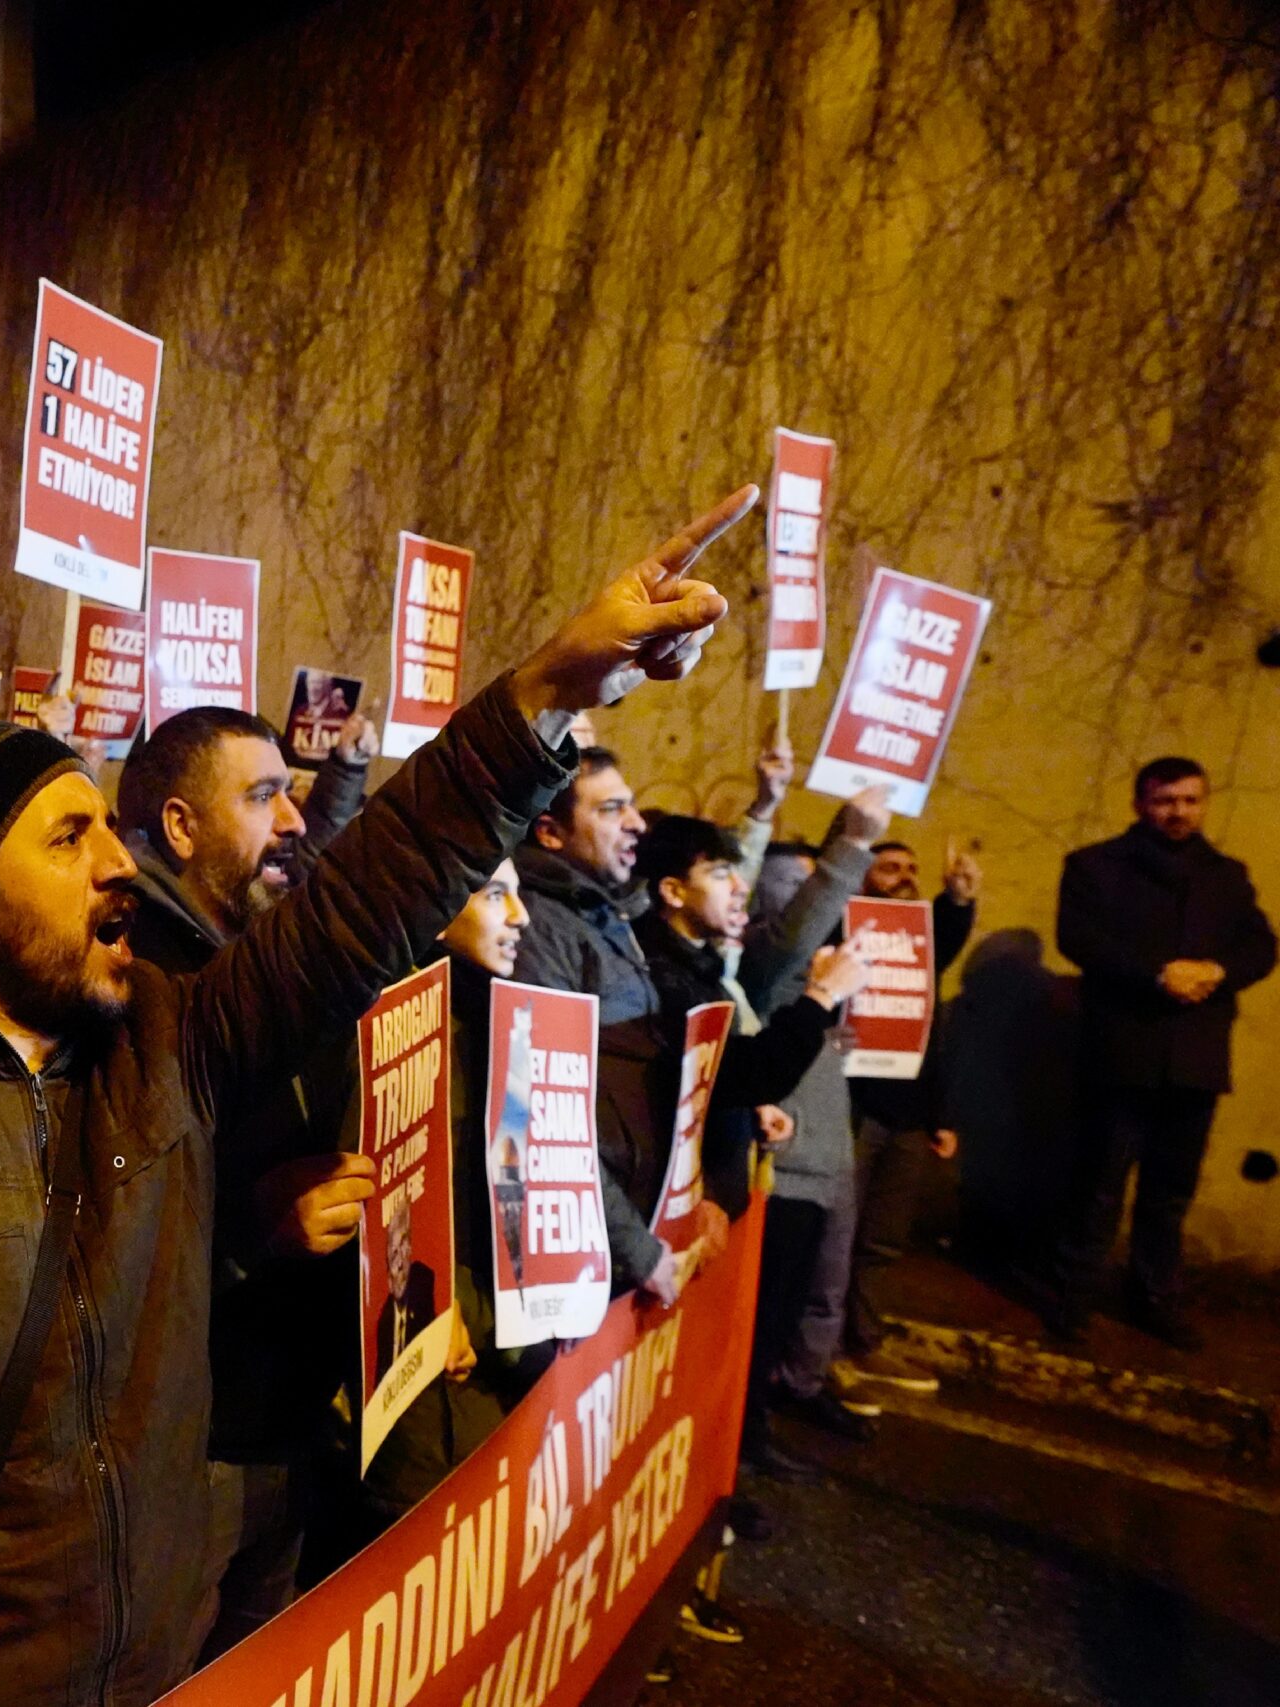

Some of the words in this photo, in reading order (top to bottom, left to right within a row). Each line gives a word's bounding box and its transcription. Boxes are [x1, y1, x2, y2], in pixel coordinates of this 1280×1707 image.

[46, 340, 77, 389] 57
[80, 356, 145, 422] LİDER
[45, 395, 57, 436] 1
[64, 402, 141, 472] HALİFE
[38, 446, 136, 520] ETMİYOR!
[89, 624, 145, 656] GAZZE
[161, 597, 243, 641] HALİFEN
[877, 602, 962, 656] GAZZE
[84, 651, 140, 687] İSLAM
[158, 638, 243, 686] YOKSA
[371, 982, 443, 1071] ARROGANT
[373, 1038, 442, 1153] TRUMP
[530, 1090, 589, 1143] SANA
[528, 1190, 605, 1255] FEDA
[519, 1410, 573, 1589] BİL
[576, 1308, 683, 1505] TRUMP!
[605, 1415, 694, 1614] YETER
